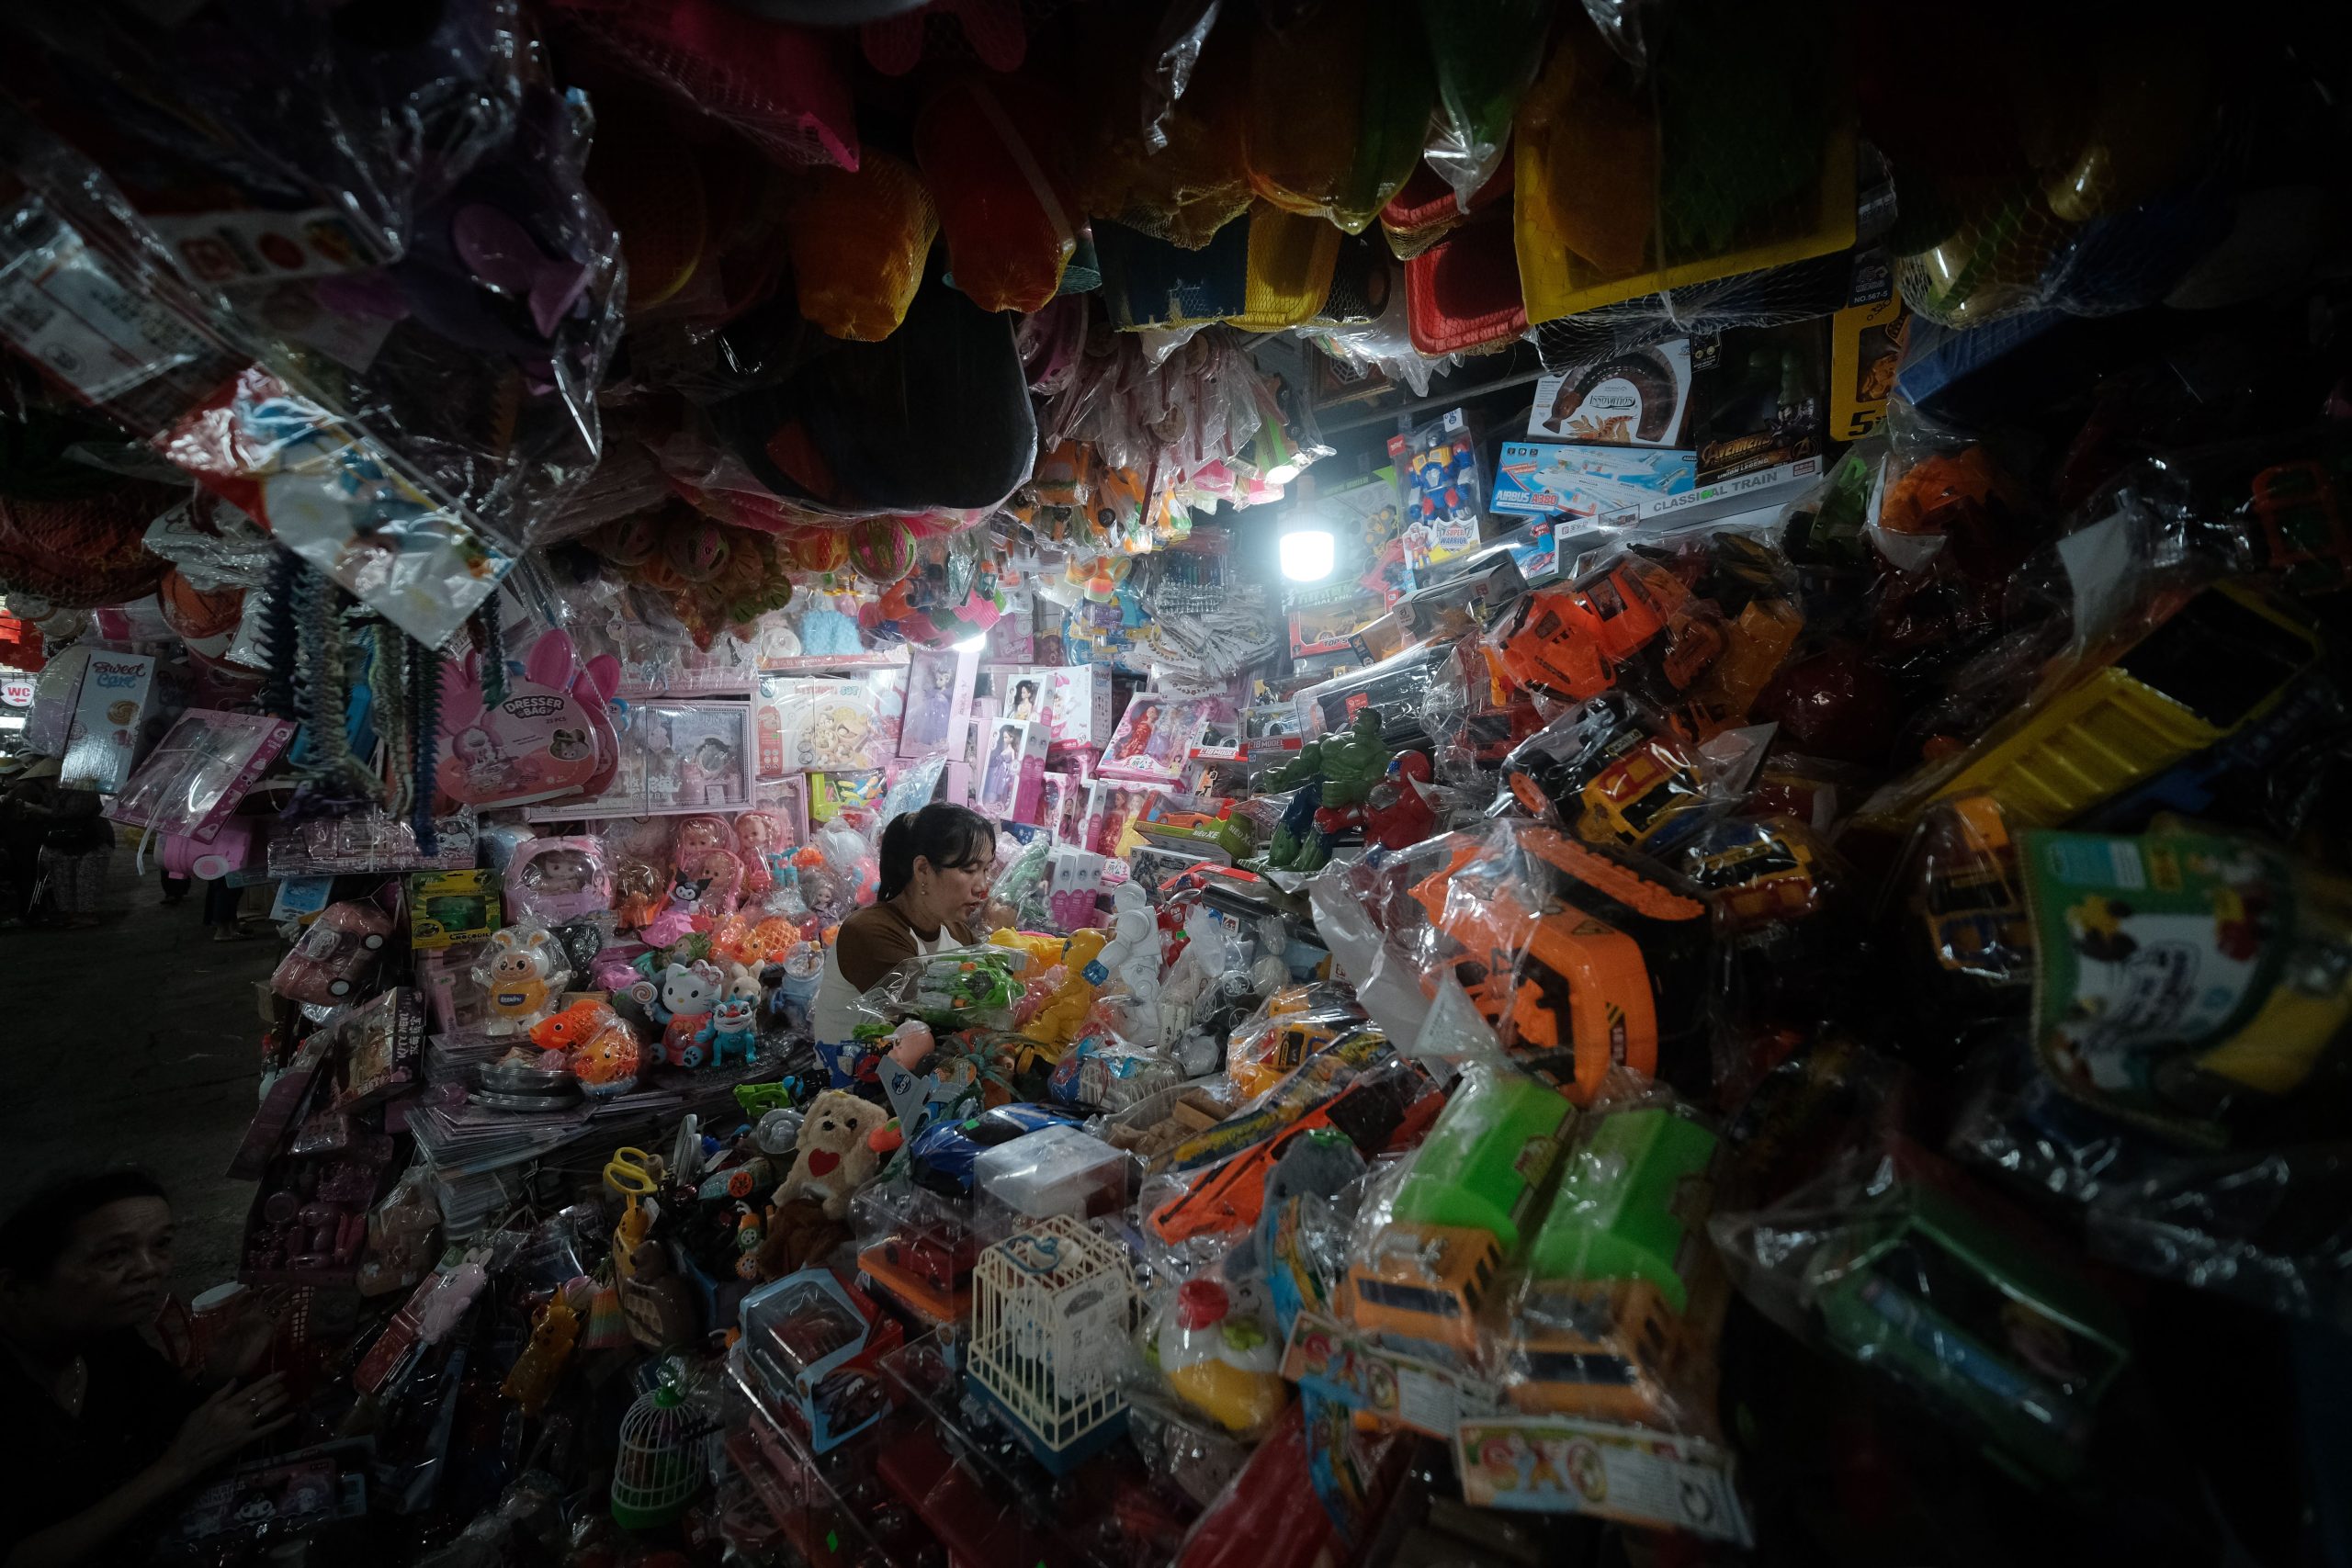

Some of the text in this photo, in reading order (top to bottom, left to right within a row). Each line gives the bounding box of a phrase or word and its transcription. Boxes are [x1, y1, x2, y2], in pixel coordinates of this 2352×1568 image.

[1731, 471, 1778, 491] TRAIN
[1495, 491, 1530, 503] AIRBUS
[1445, 528, 1466, 537] SUPER
[1440, 536, 1468, 546] WARRIOR
[7, 686, 31, 698] WC
[503, 697, 564, 714] DRESSER
[523, 705, 547, 716] BAG
[1261, 739, 1284, 748] MODEL
[1207, 829, 1220, 840] XE
